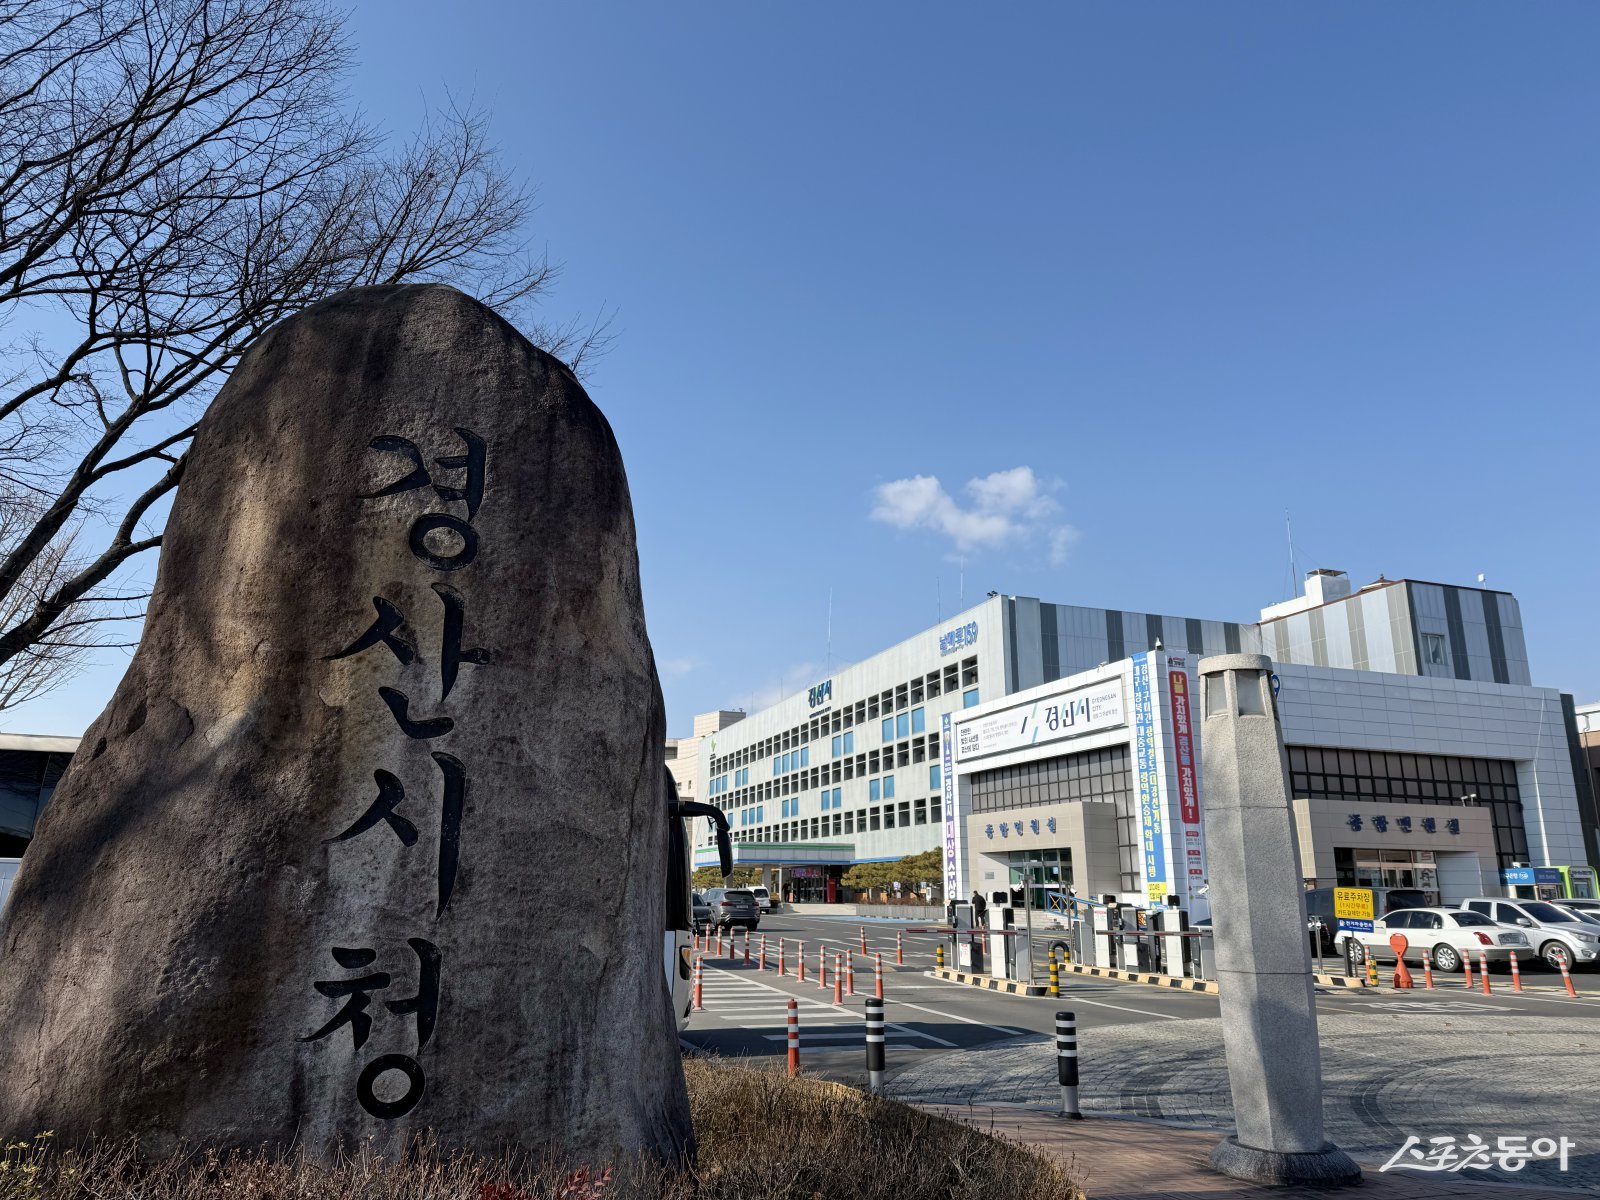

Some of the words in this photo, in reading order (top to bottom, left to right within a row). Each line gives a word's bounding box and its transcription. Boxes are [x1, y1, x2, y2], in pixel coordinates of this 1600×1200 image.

[1044, 696, 1091, 731] 경산시
[1175, 695, 1188, 734] 가치있게
[295, 427, 493, 1120] 경산시청
[1181, 767, 1195, 807] 가치있게
[946, 820, 955, 858] 대상
[947, 861, 957, 900] 수상
[1337, 891, 1370, 903] 유료주차장
